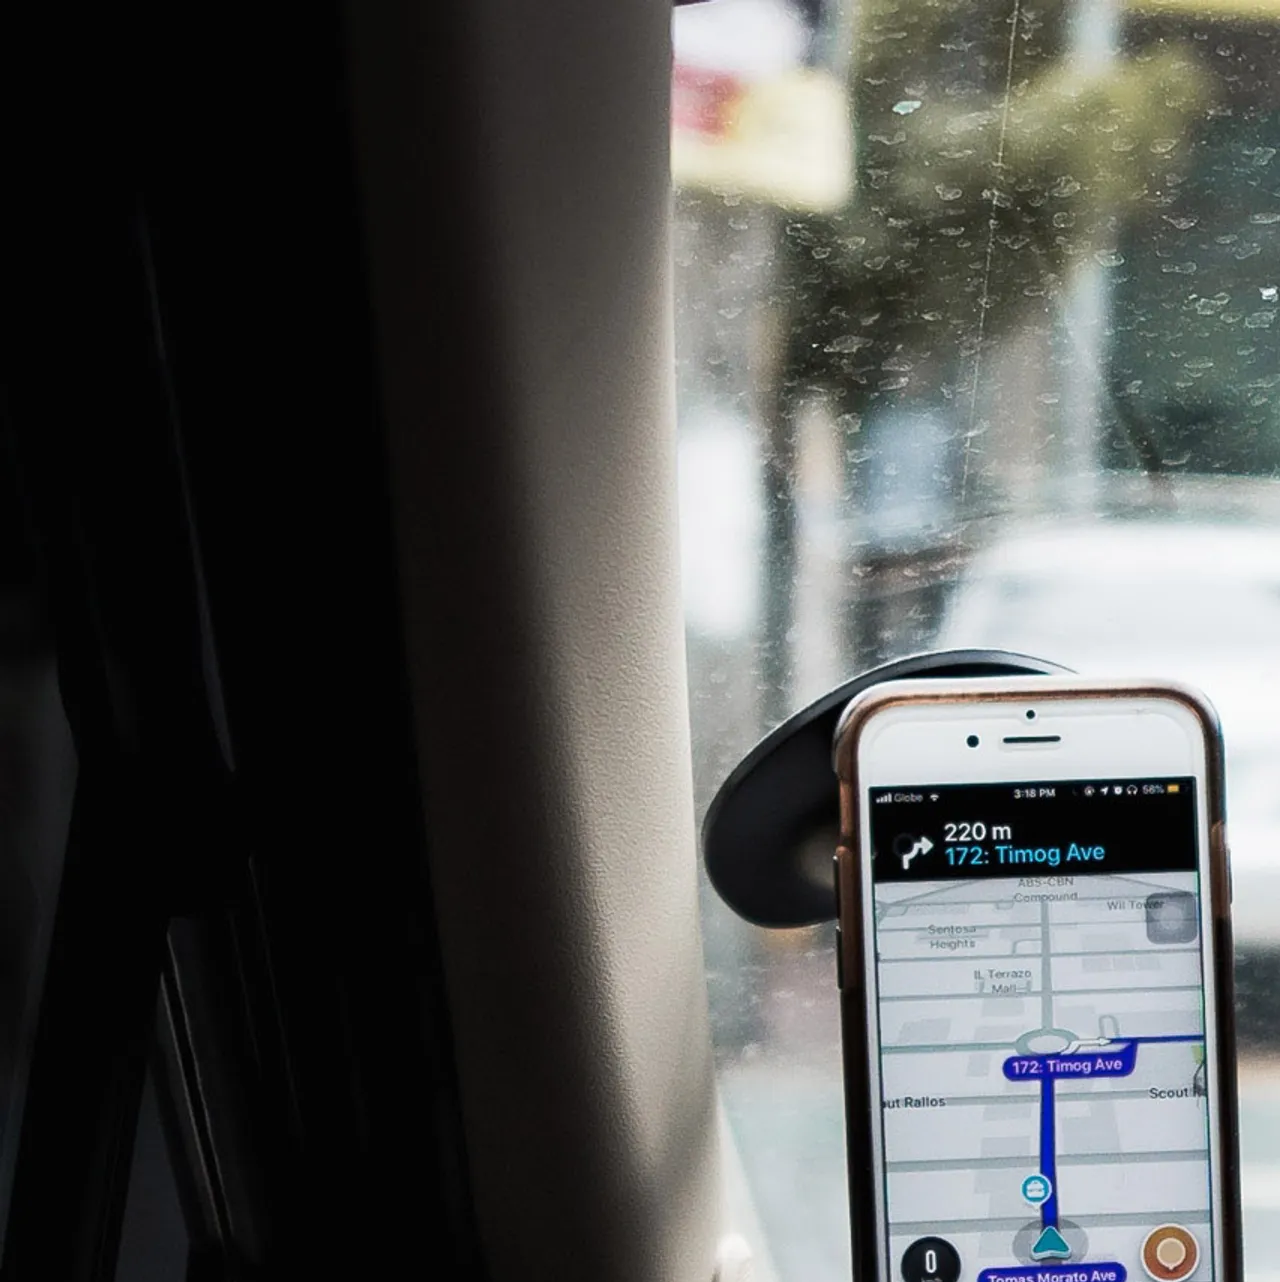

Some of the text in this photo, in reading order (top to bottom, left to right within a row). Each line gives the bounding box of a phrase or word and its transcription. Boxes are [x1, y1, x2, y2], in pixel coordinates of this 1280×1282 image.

[894, 793, 924, 803] Globe
[1014, 787, 1056, 800] 3:18 PM
[944, 821, 1012, 842] 220 m
[945, 842, 1105, 866] 172: Timog Ave
[927, 924, 977, 936] Sentosa
[930, 939, 976, 951] Heights
[1012, 1056, 1123, 1075] 172: Timog Ave
[1149, 1087, 1188, 1099] Scout
[904, 1096, 946, 1108] Rallos
[925, 1249, 937, 1273] 0
[1090, 1269, 1117, 1282] Ave
